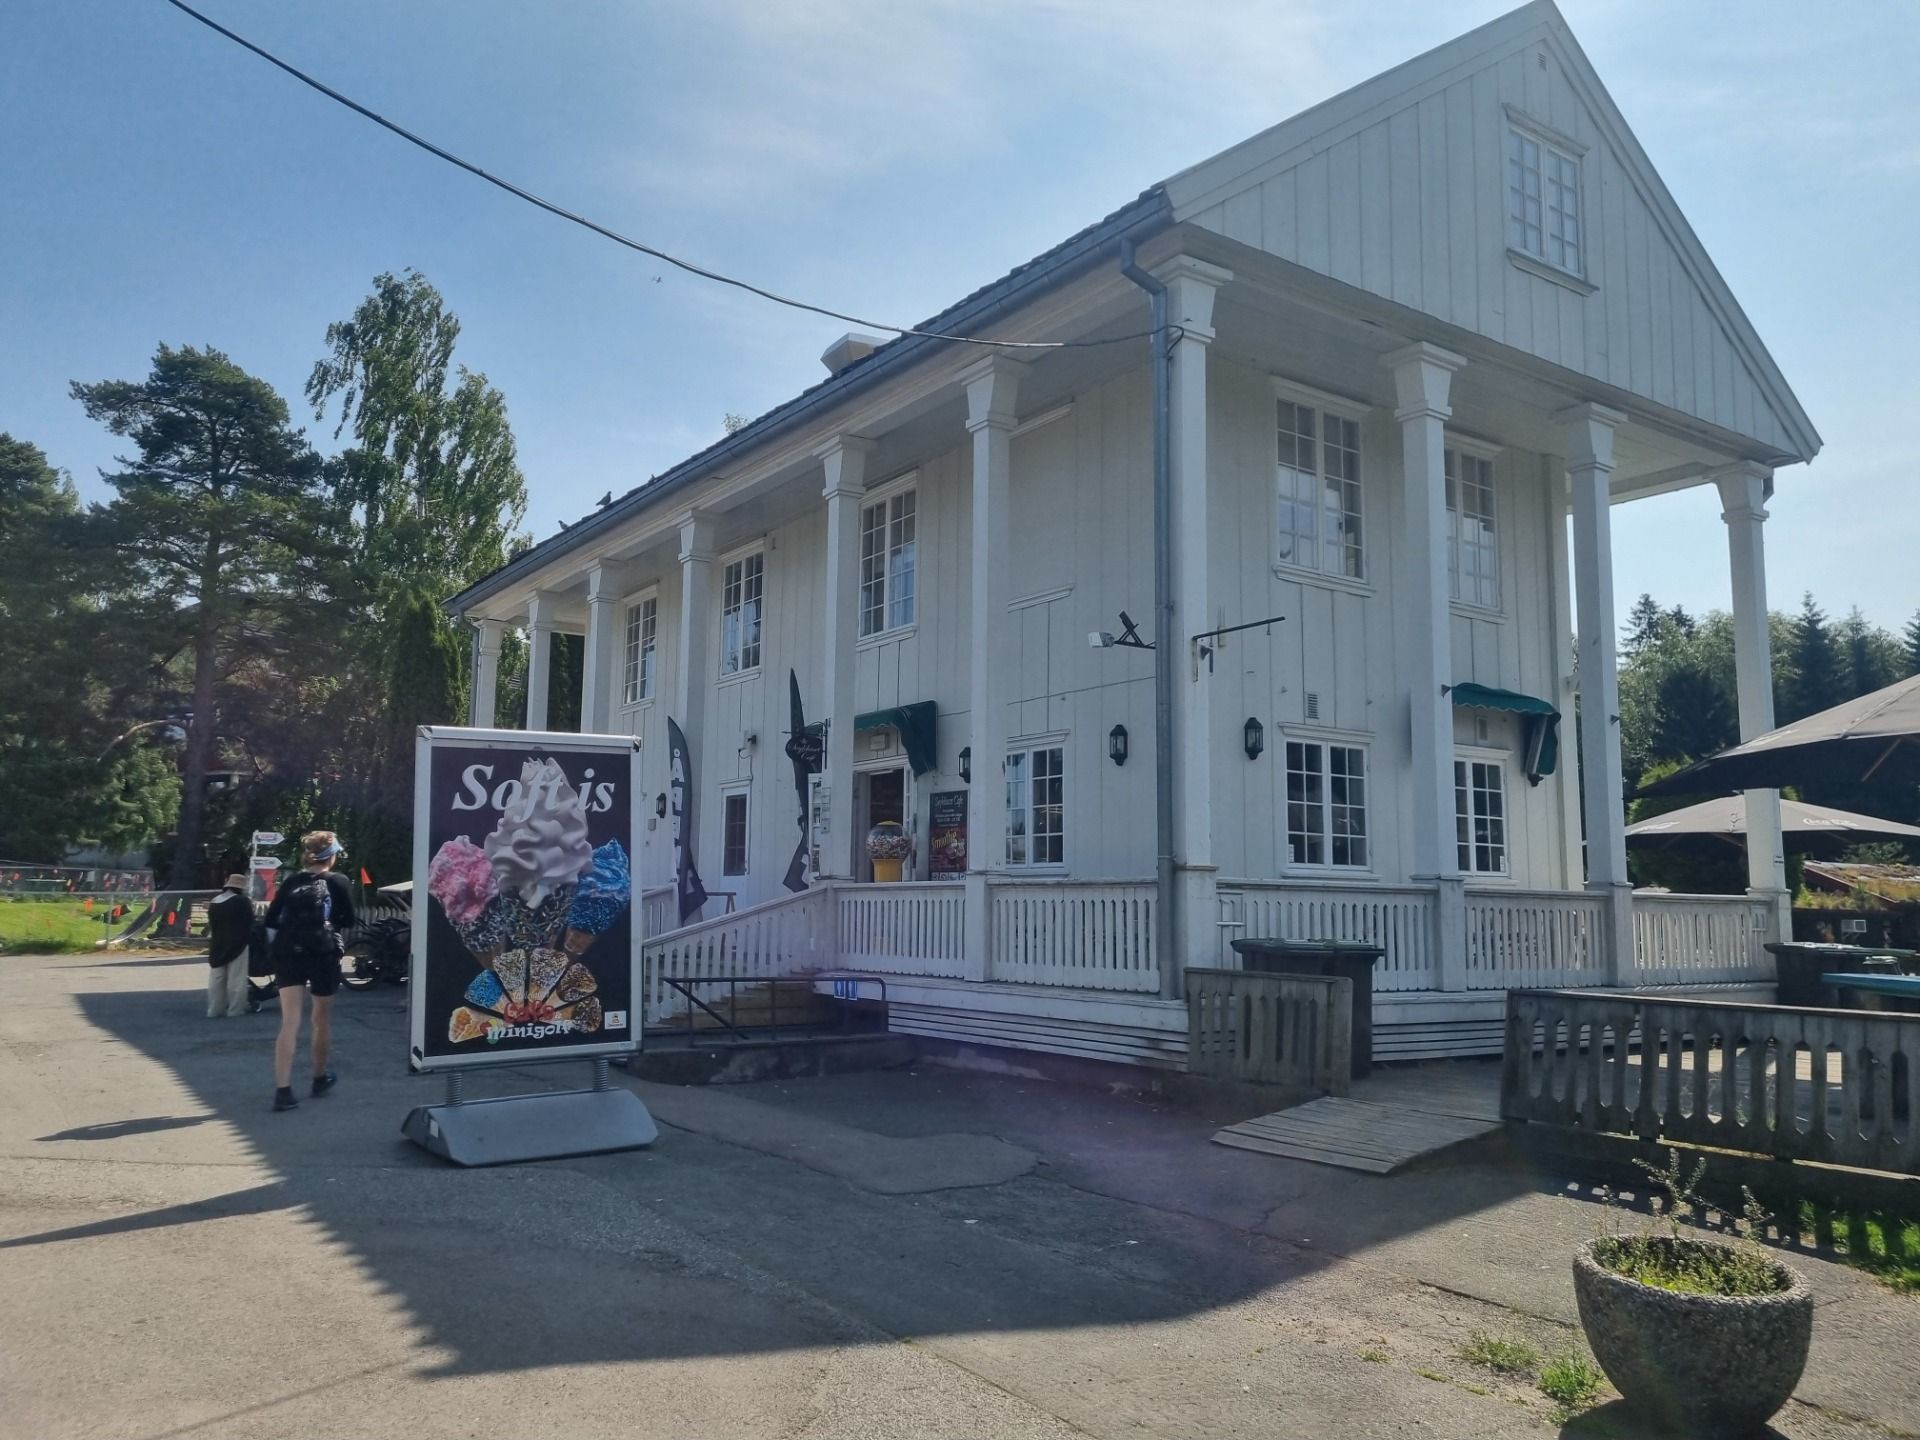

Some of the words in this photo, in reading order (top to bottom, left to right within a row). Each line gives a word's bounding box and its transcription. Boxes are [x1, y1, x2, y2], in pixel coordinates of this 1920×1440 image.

[452, 764, 563, 822] Soft
[578, 768, 615, 812] is
[487, 1019, 574, 1040] minigolf
